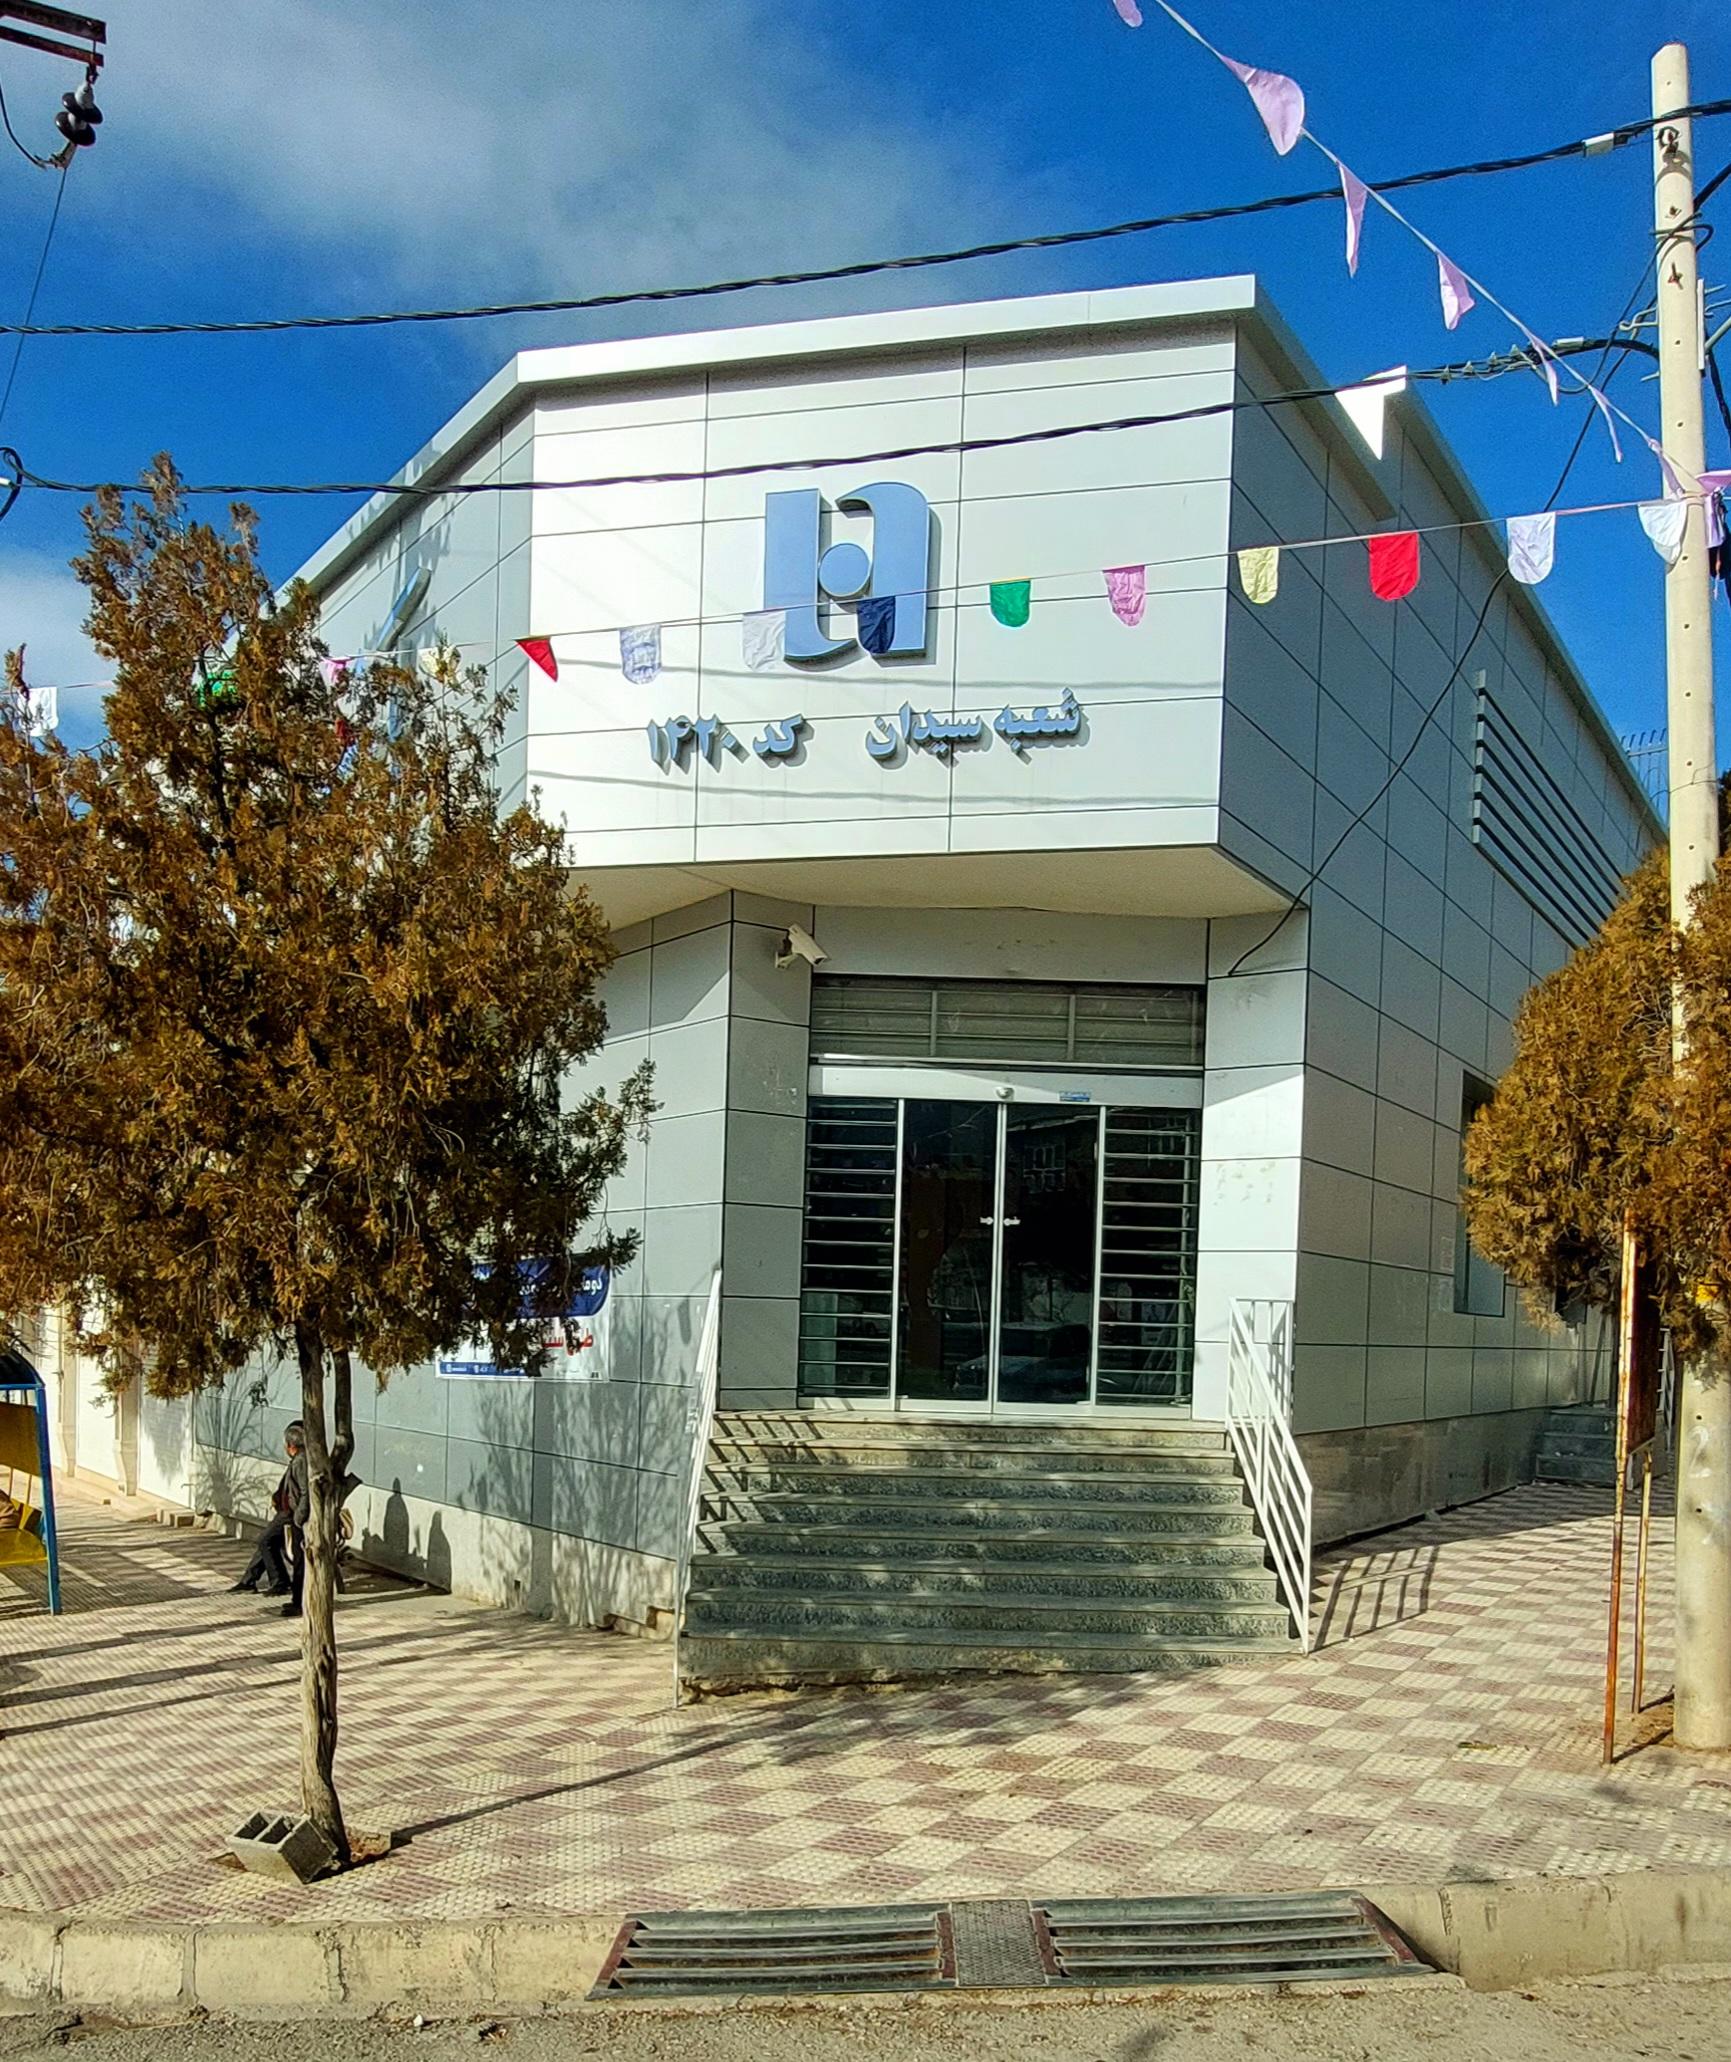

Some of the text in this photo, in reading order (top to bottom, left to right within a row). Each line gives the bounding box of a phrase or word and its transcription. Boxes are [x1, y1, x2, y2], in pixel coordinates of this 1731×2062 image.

[647, 687, 1082, 762] شعبه سیدان کد ۱۴۲۰
